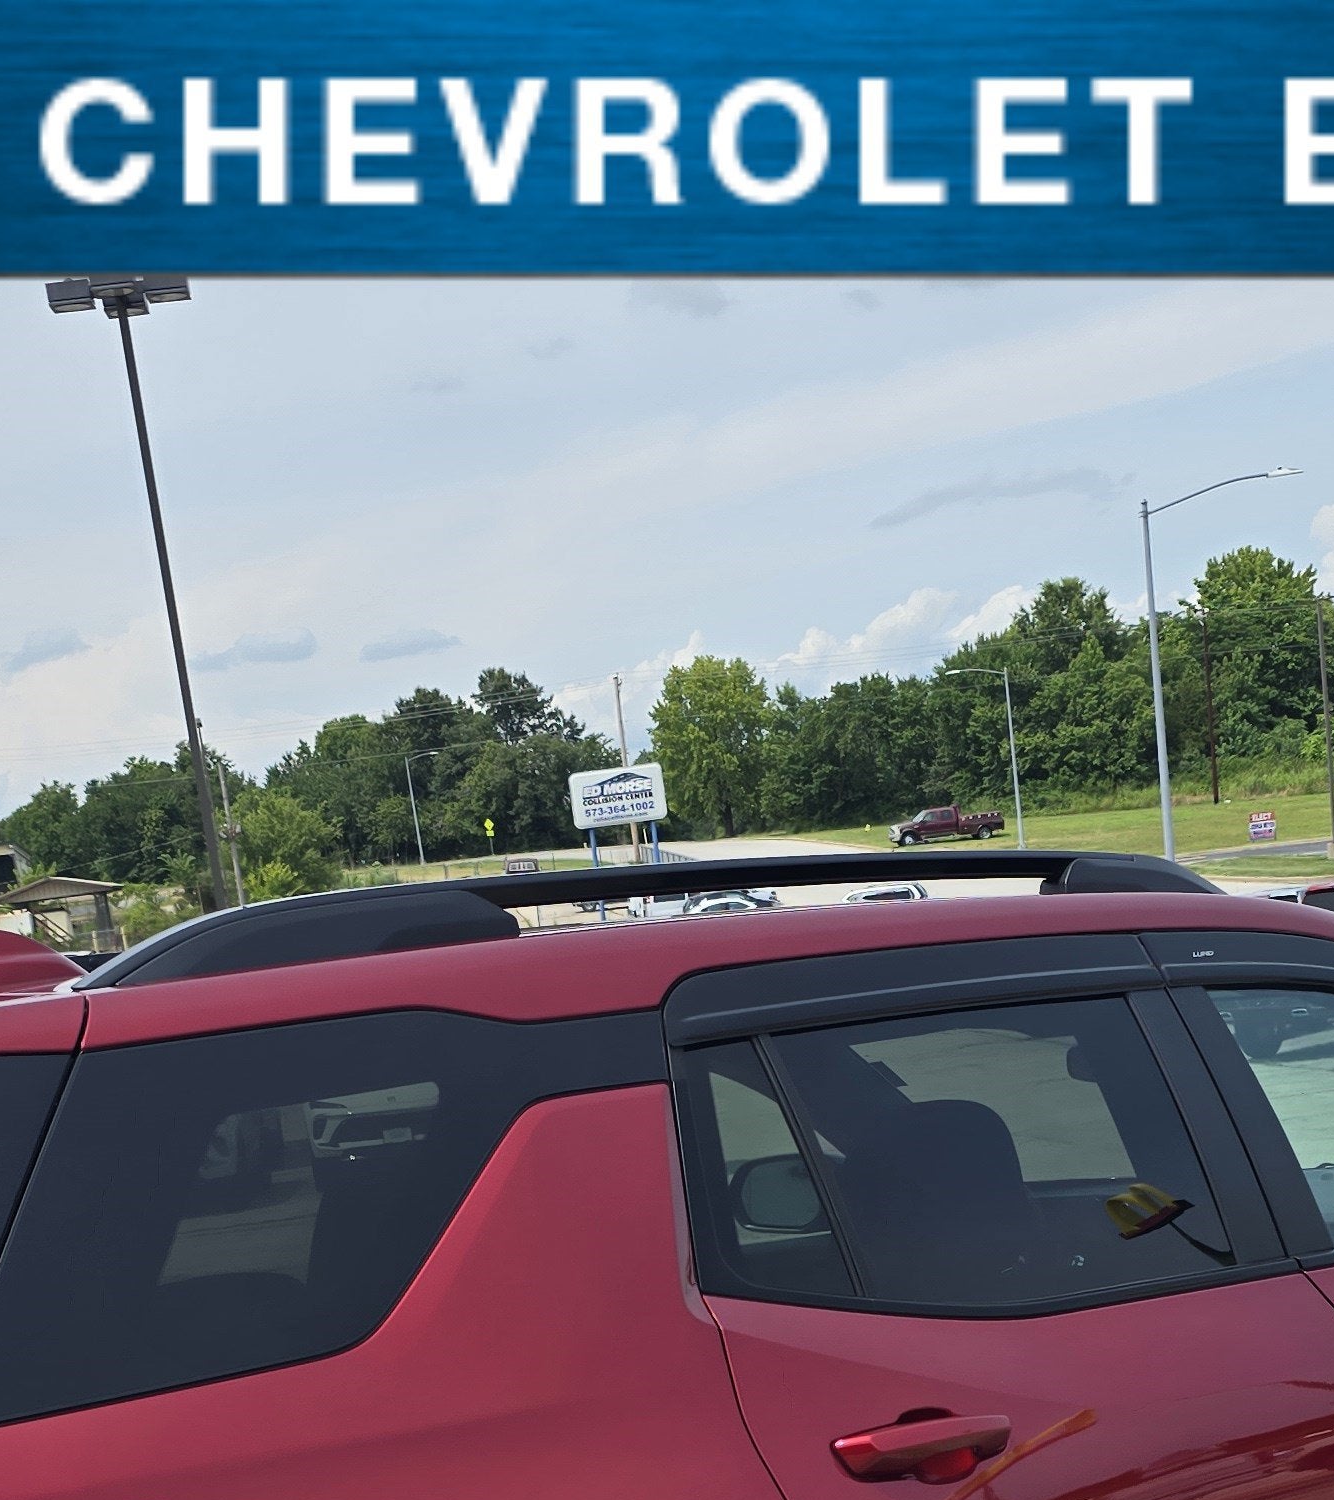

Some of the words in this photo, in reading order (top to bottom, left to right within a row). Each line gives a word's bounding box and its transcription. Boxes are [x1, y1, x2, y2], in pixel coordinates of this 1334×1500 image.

[583, 786, 602, 798] ED
[603, 778, 652, 795] MORSE
[583, 795, 623, 806] COLLISION
[625, 792, 653, 801] CENTER
[585, 801, 655, 817] 573-364-1002
